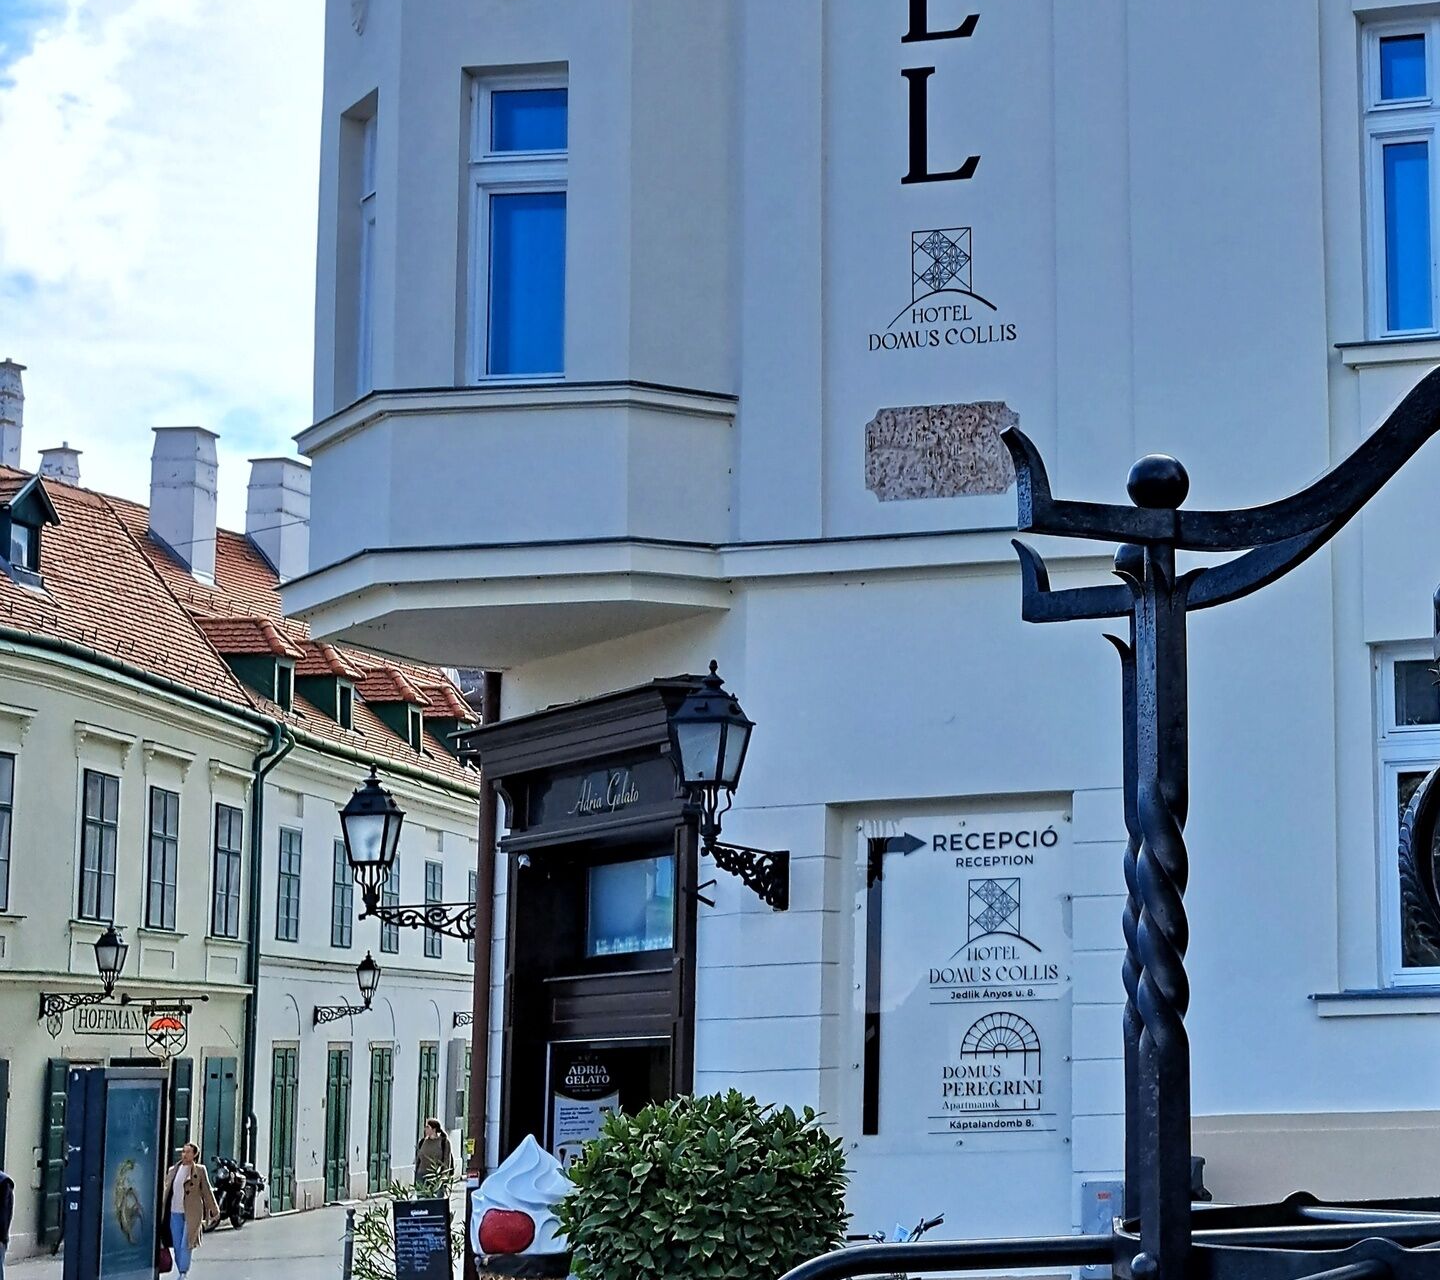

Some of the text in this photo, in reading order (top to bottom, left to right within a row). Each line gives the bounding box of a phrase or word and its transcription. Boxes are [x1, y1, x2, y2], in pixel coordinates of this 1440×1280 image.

[912, 305, 973, 324] HOTEL
[868, 324, 1017, 351] DOMUS COLLIS
[568, 771, 639, 814] Adria Gelato
[933, 825, 1058, 852] RECEPCIÓ
[956, 854, 1034, 868] RECEPTION
[967, 946, 1020, 961] HOTEL
[929, 964, 1059, 984] DOMUS COLLIS
[950, 988, 1036, 1000] Jedlik Ányos u. 8.
[568, 1065, 607, 1075] ADRIA
[942, 1065, 1001, 1079] DOMUS
[565, 1074, 610, 1085] GELATO
[942, 1080, 1043, 1097] PEREGRINI
[942, 1099, 1001, 1111] Apartmanok
[949, 1119, 1034, 1130] Káptalandomb 8.
